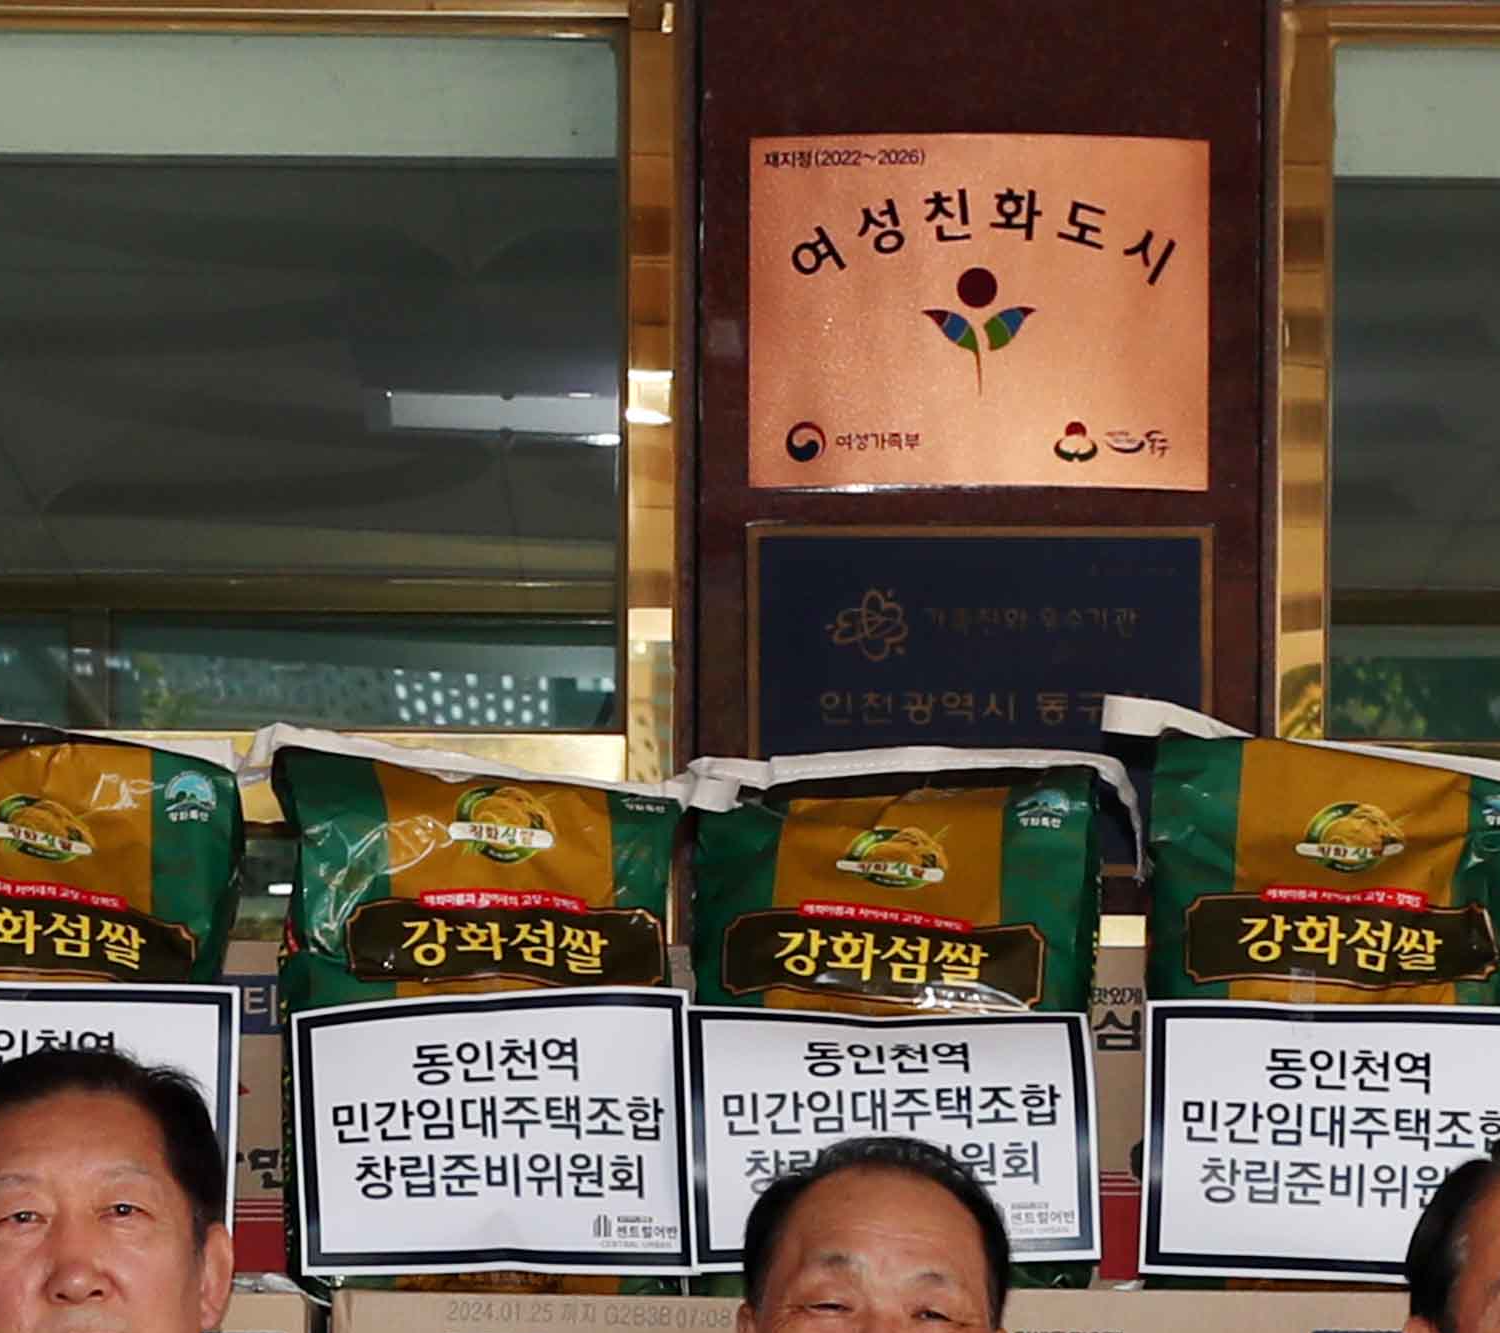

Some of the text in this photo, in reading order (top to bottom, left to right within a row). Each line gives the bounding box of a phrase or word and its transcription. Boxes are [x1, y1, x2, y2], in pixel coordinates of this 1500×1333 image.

[790, 187, 1178, 286] 여성친화도시
[835, 430, 921, 452] 여성가족부
[818, 689, 1019, 727] 인천광역시
[402, 917, 609, 974] 강화섬쌀
[774, 928, 989, 984] 강화섬쌀
[1238, 913, 1443, 973] 강화섬쌀
[1092, 1011, 1143, 1051] 심
[412, 1037, 580, 1085] 동인천역
[803, 1040, 972, 1077] 동인천역
[1265, 1047, 1434, 1094] 동인천역
[331, 1096, 666, 1144] 민간임대주택조합
[722, 1084, 1062, 1137] 민간임대주택조합
[355, 1153, 645, 1199] 창립준비위원회
[447, 1300, 553, 1323] 2024.01.25
